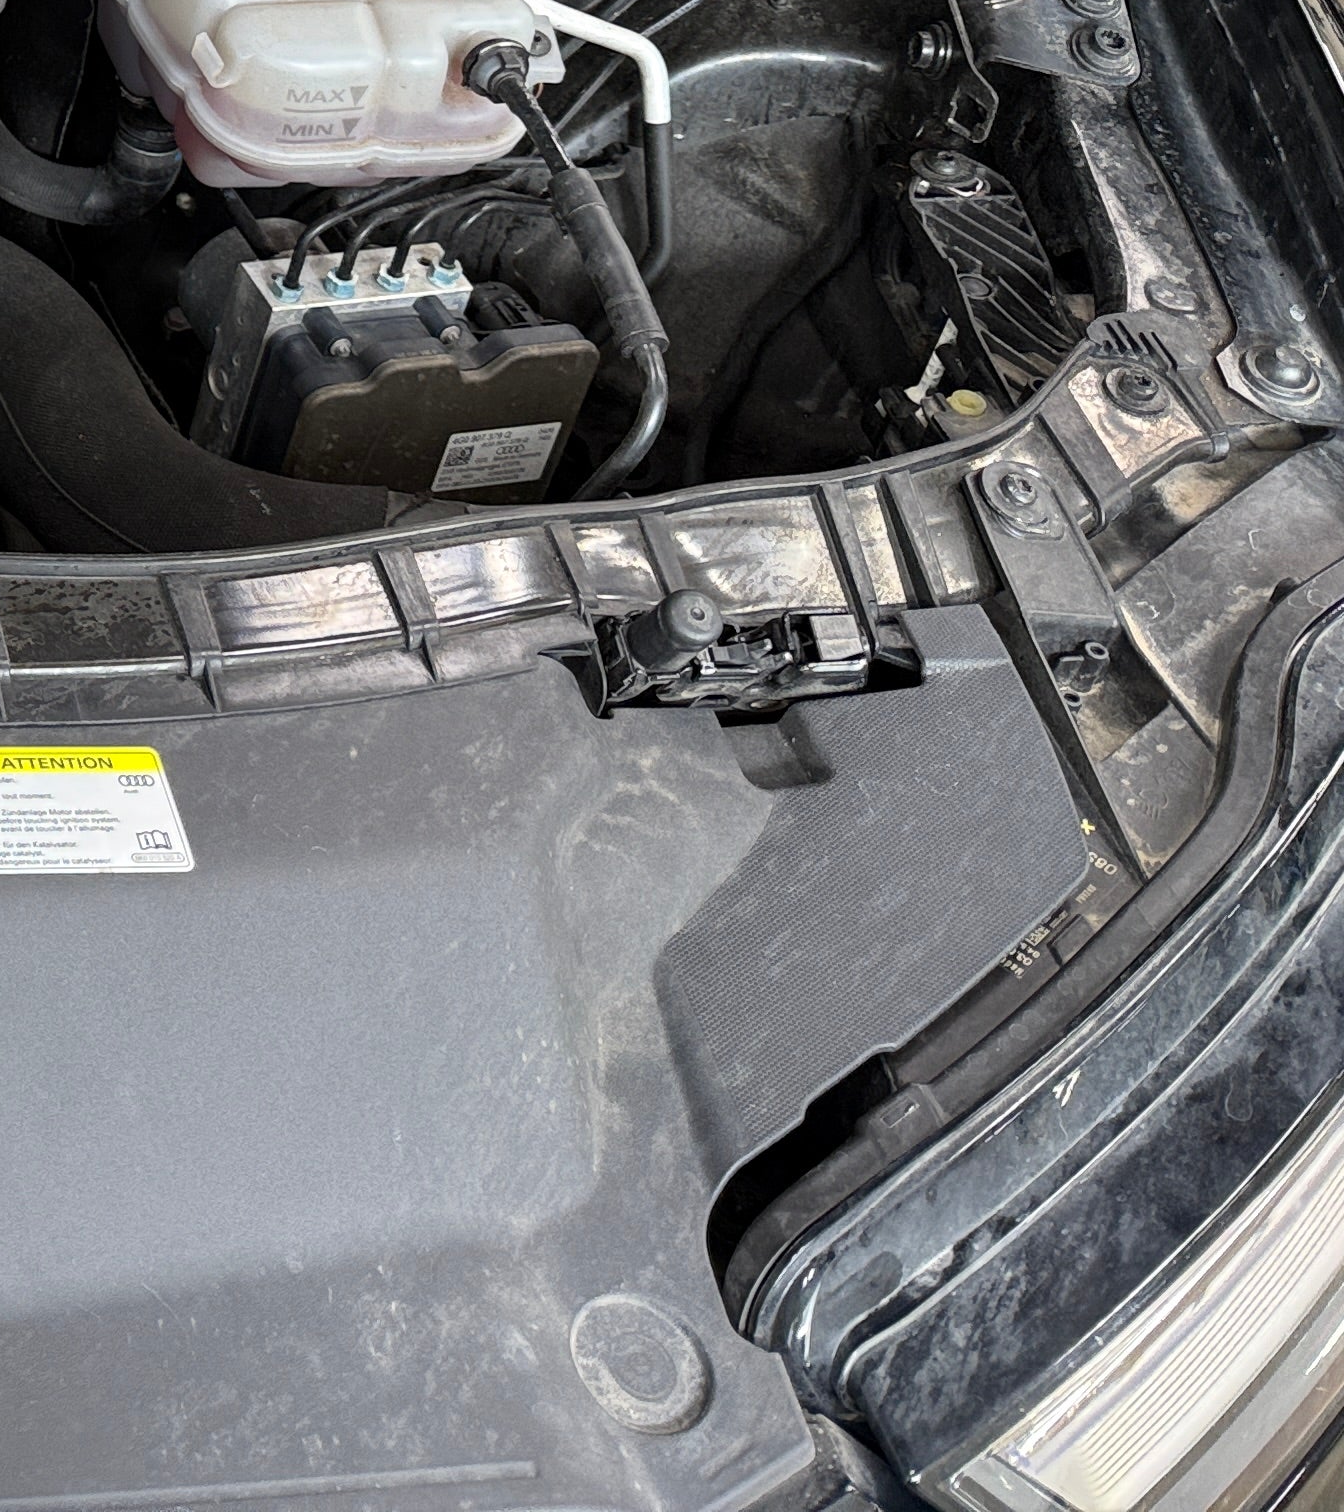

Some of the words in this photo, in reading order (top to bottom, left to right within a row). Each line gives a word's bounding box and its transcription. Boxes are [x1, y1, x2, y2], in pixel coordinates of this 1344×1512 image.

[286, 88, 346, 104] MAX
[281, 123, 335, 137] MIN
[1, 755, 113, 771] ATTENTION
